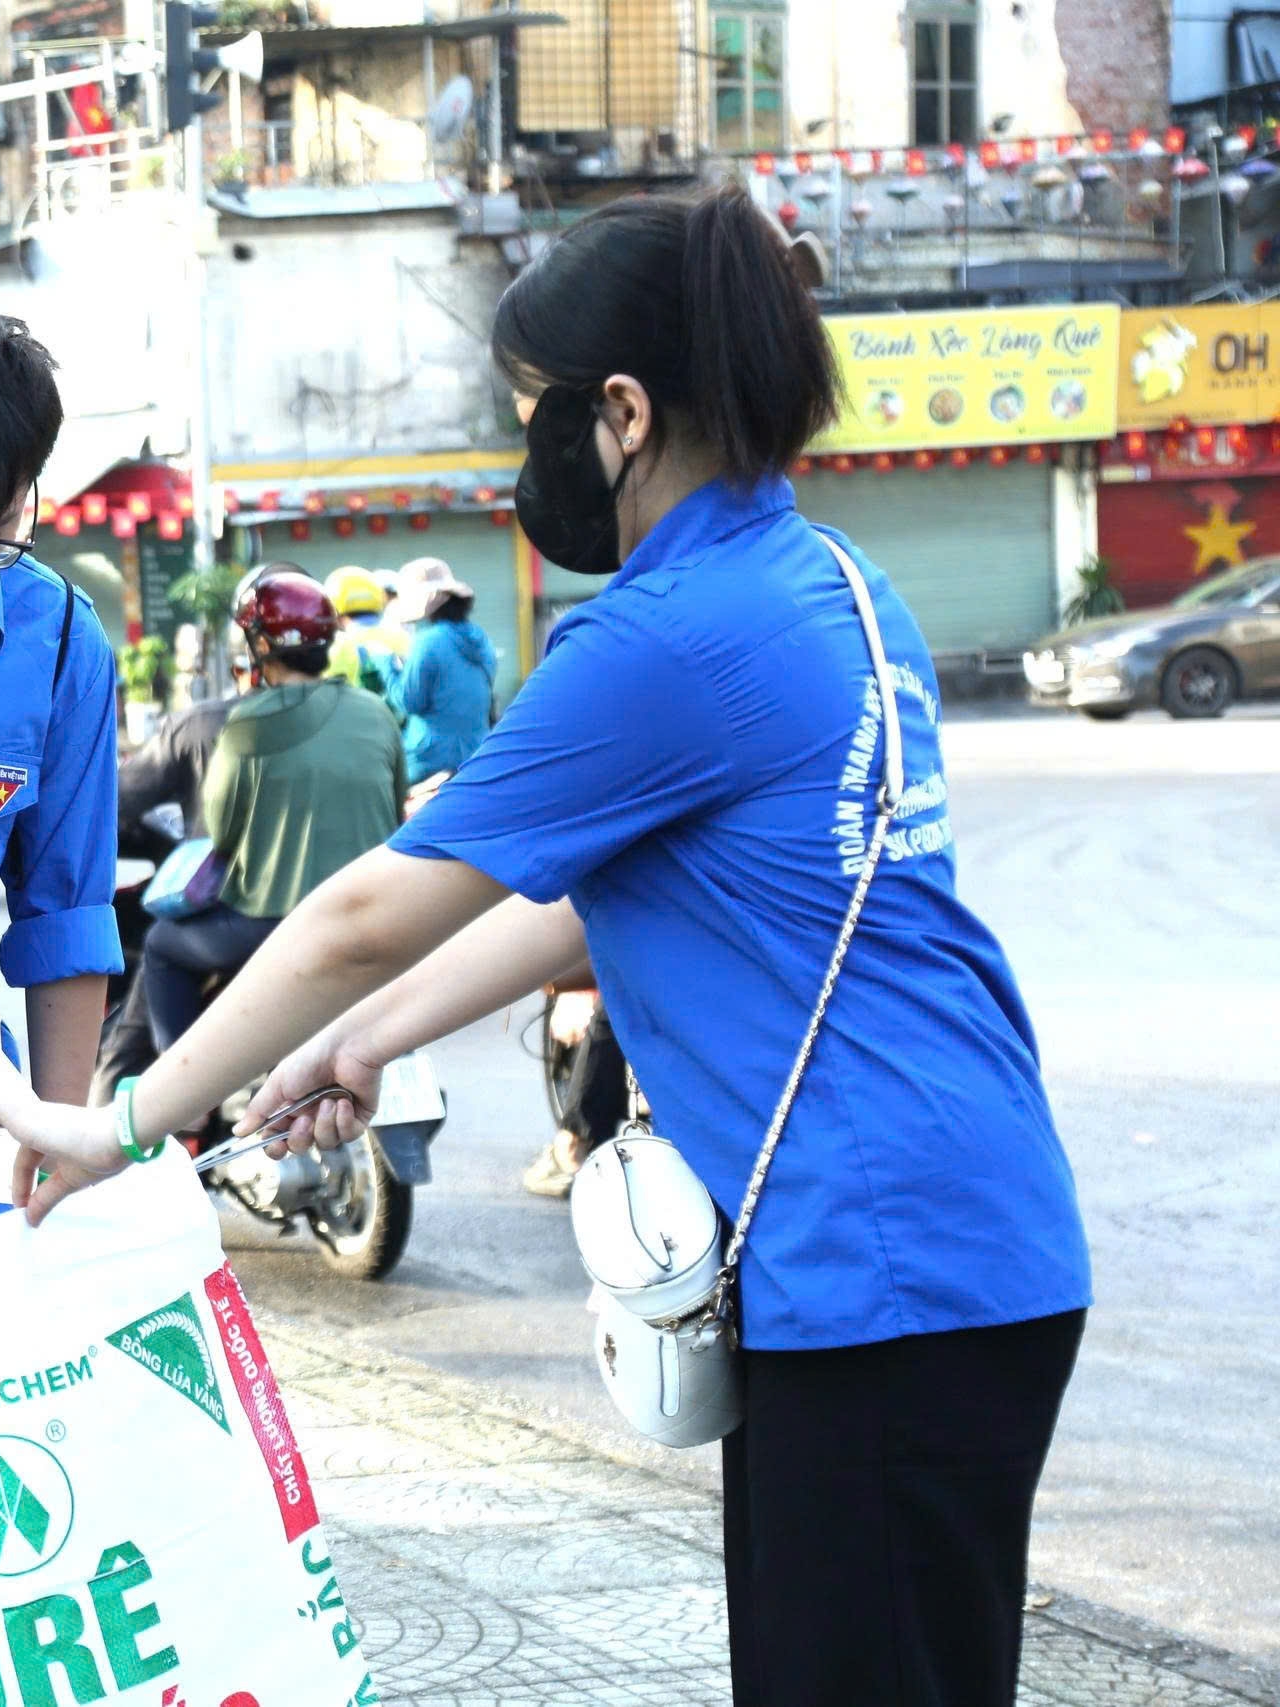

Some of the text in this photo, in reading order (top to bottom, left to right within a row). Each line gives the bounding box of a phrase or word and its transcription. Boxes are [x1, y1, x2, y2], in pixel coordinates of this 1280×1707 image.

[1213, 333, 1270, 374] OH
[213, 1295, 234, 1324] TẾ
[120, 1333, 224, 1421] BÔNG LÚA VÀNG
[225, 1323, 259, 1380] QUỐC
[274, 1451, 302, 1506] CHẤT
